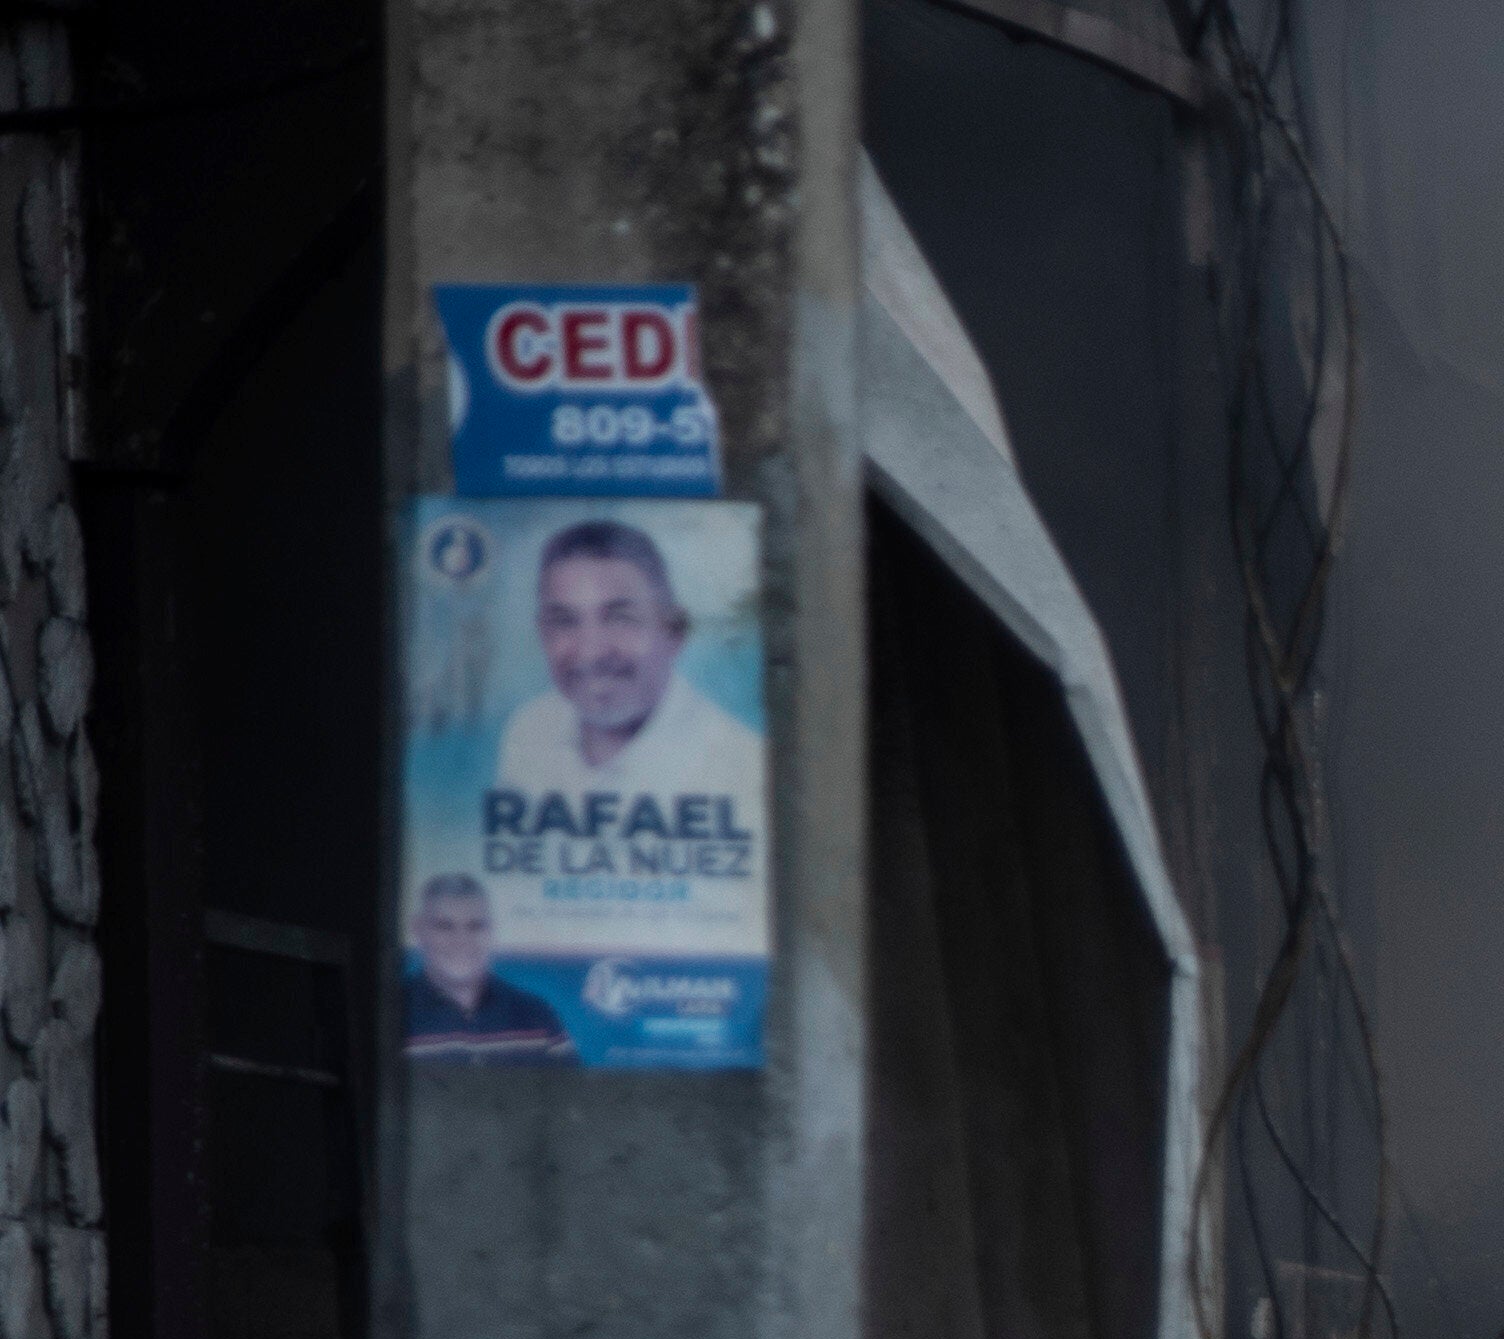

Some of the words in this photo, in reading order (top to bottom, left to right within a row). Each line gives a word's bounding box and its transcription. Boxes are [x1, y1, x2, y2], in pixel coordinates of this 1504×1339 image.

[482, 789, 753, 841] RAFAEL
[483, 839, 544, 875] DE
[560, 840, 617, 876] LA
[628, 842, 753, 879] NUEZ
